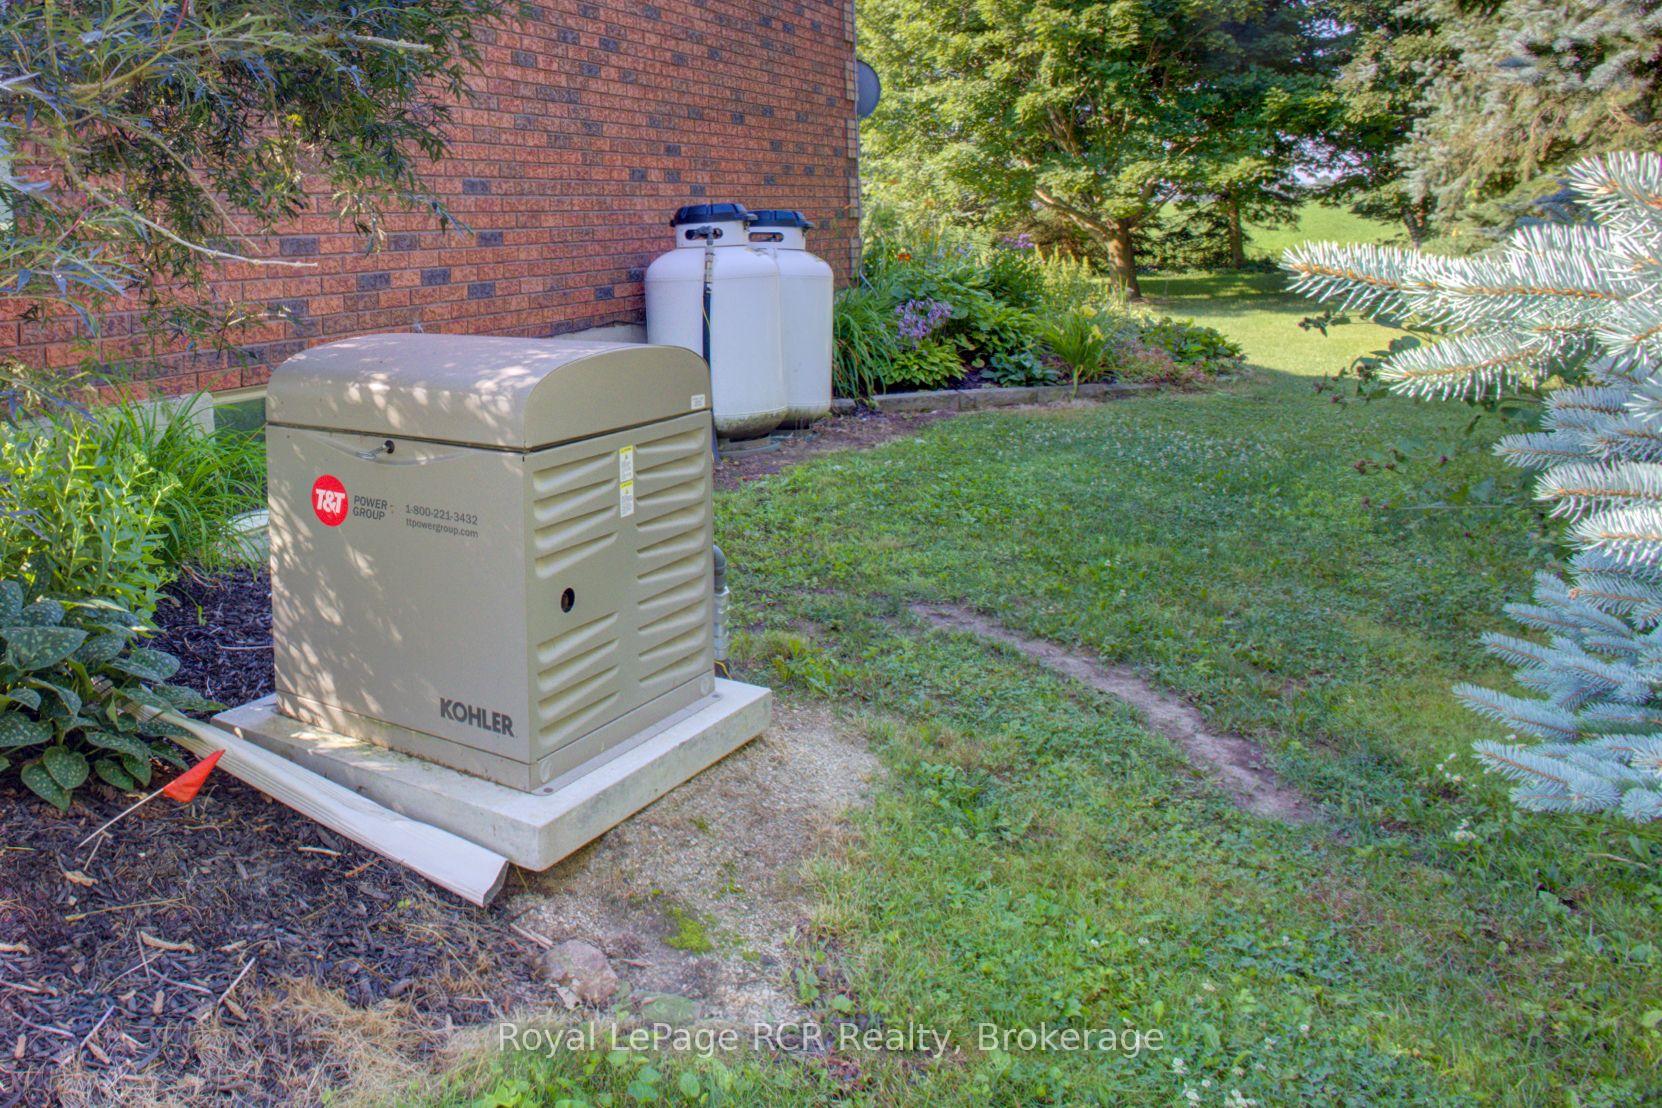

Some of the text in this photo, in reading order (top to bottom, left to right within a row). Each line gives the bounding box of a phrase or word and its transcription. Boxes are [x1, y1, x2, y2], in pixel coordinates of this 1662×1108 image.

[315, 488, 346, 516] T&T
[354, 495, 388, 511] POWER
[353, 506, 386, 521] GROUP
[405, 504, 479, 526] 1-800-221-3432
[406, 518, 479, 538] ttpowergroup.com
[440, 697, 515, 738] KOHLER
